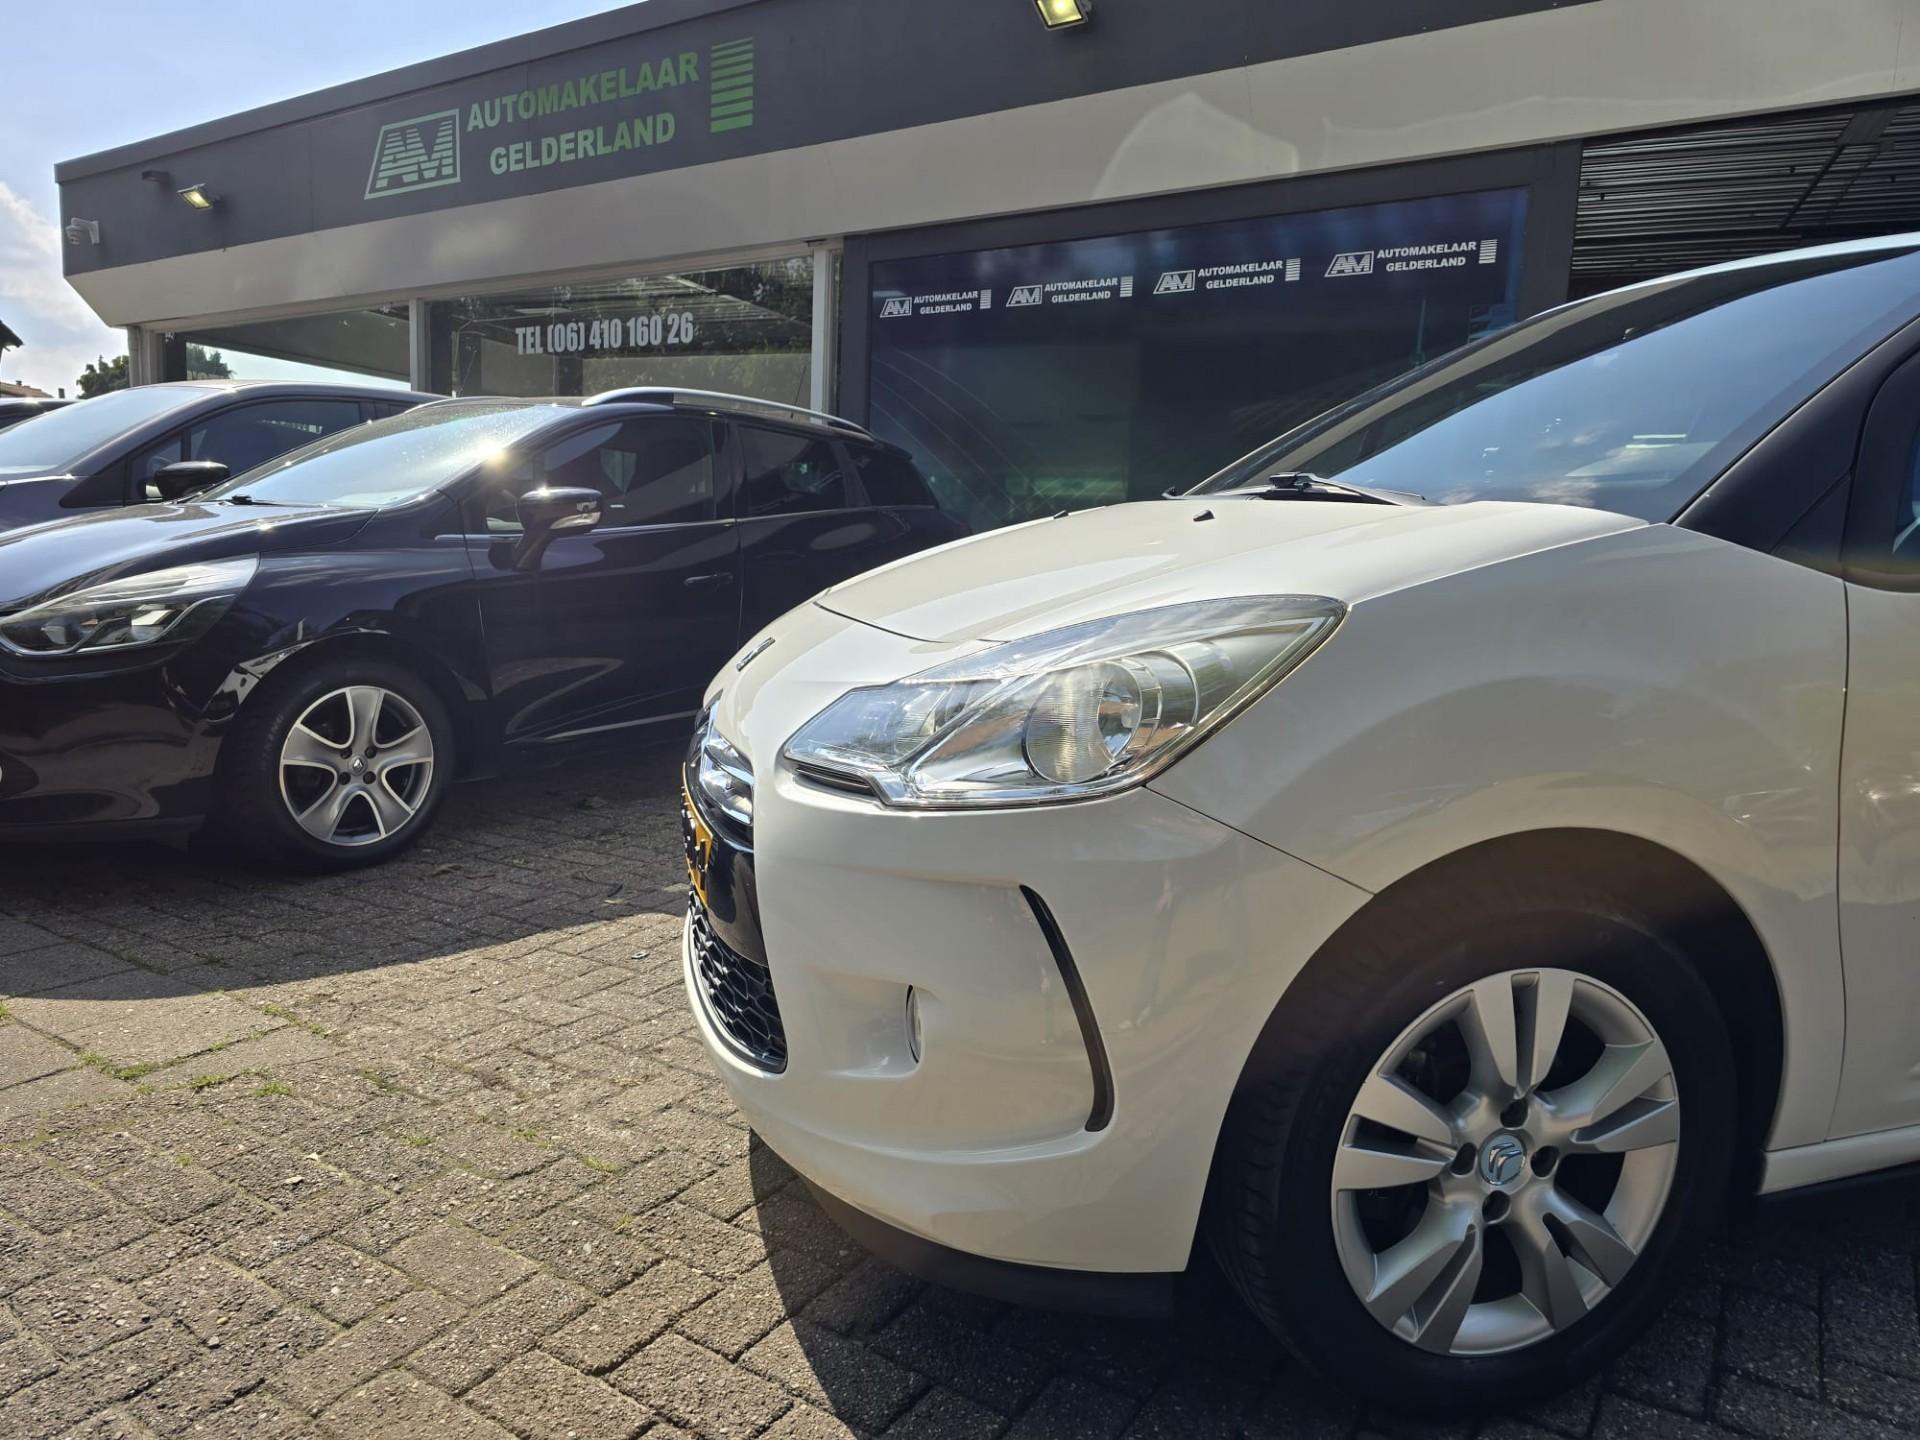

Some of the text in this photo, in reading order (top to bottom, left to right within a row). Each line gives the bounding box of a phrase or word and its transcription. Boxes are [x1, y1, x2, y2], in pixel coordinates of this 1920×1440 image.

[467, 51, 699, 132] AUTOMAKELAAR
[489, 112, 676, 176] GELDERLAND
[1377, 241, 1477, 259] AUTOMAKELAAR
[1198, 260, 1283, 277] AUTOMAKELAAR
[1386, 256, 1466, 273] GELDERLAND
[1044, 277, 1118, 292] AUTOMAKELAAR
[1206, 275, 1274, 290] GELDERLAND
[914, 290, 978, 304] AUTOMAKELAAR
[1051, 291, 1111, 304] GELDERLAND
[920, 303, 972, 315] GELDERLAND
[515, 312, 694, 355] TEL (06) 410 160 26
